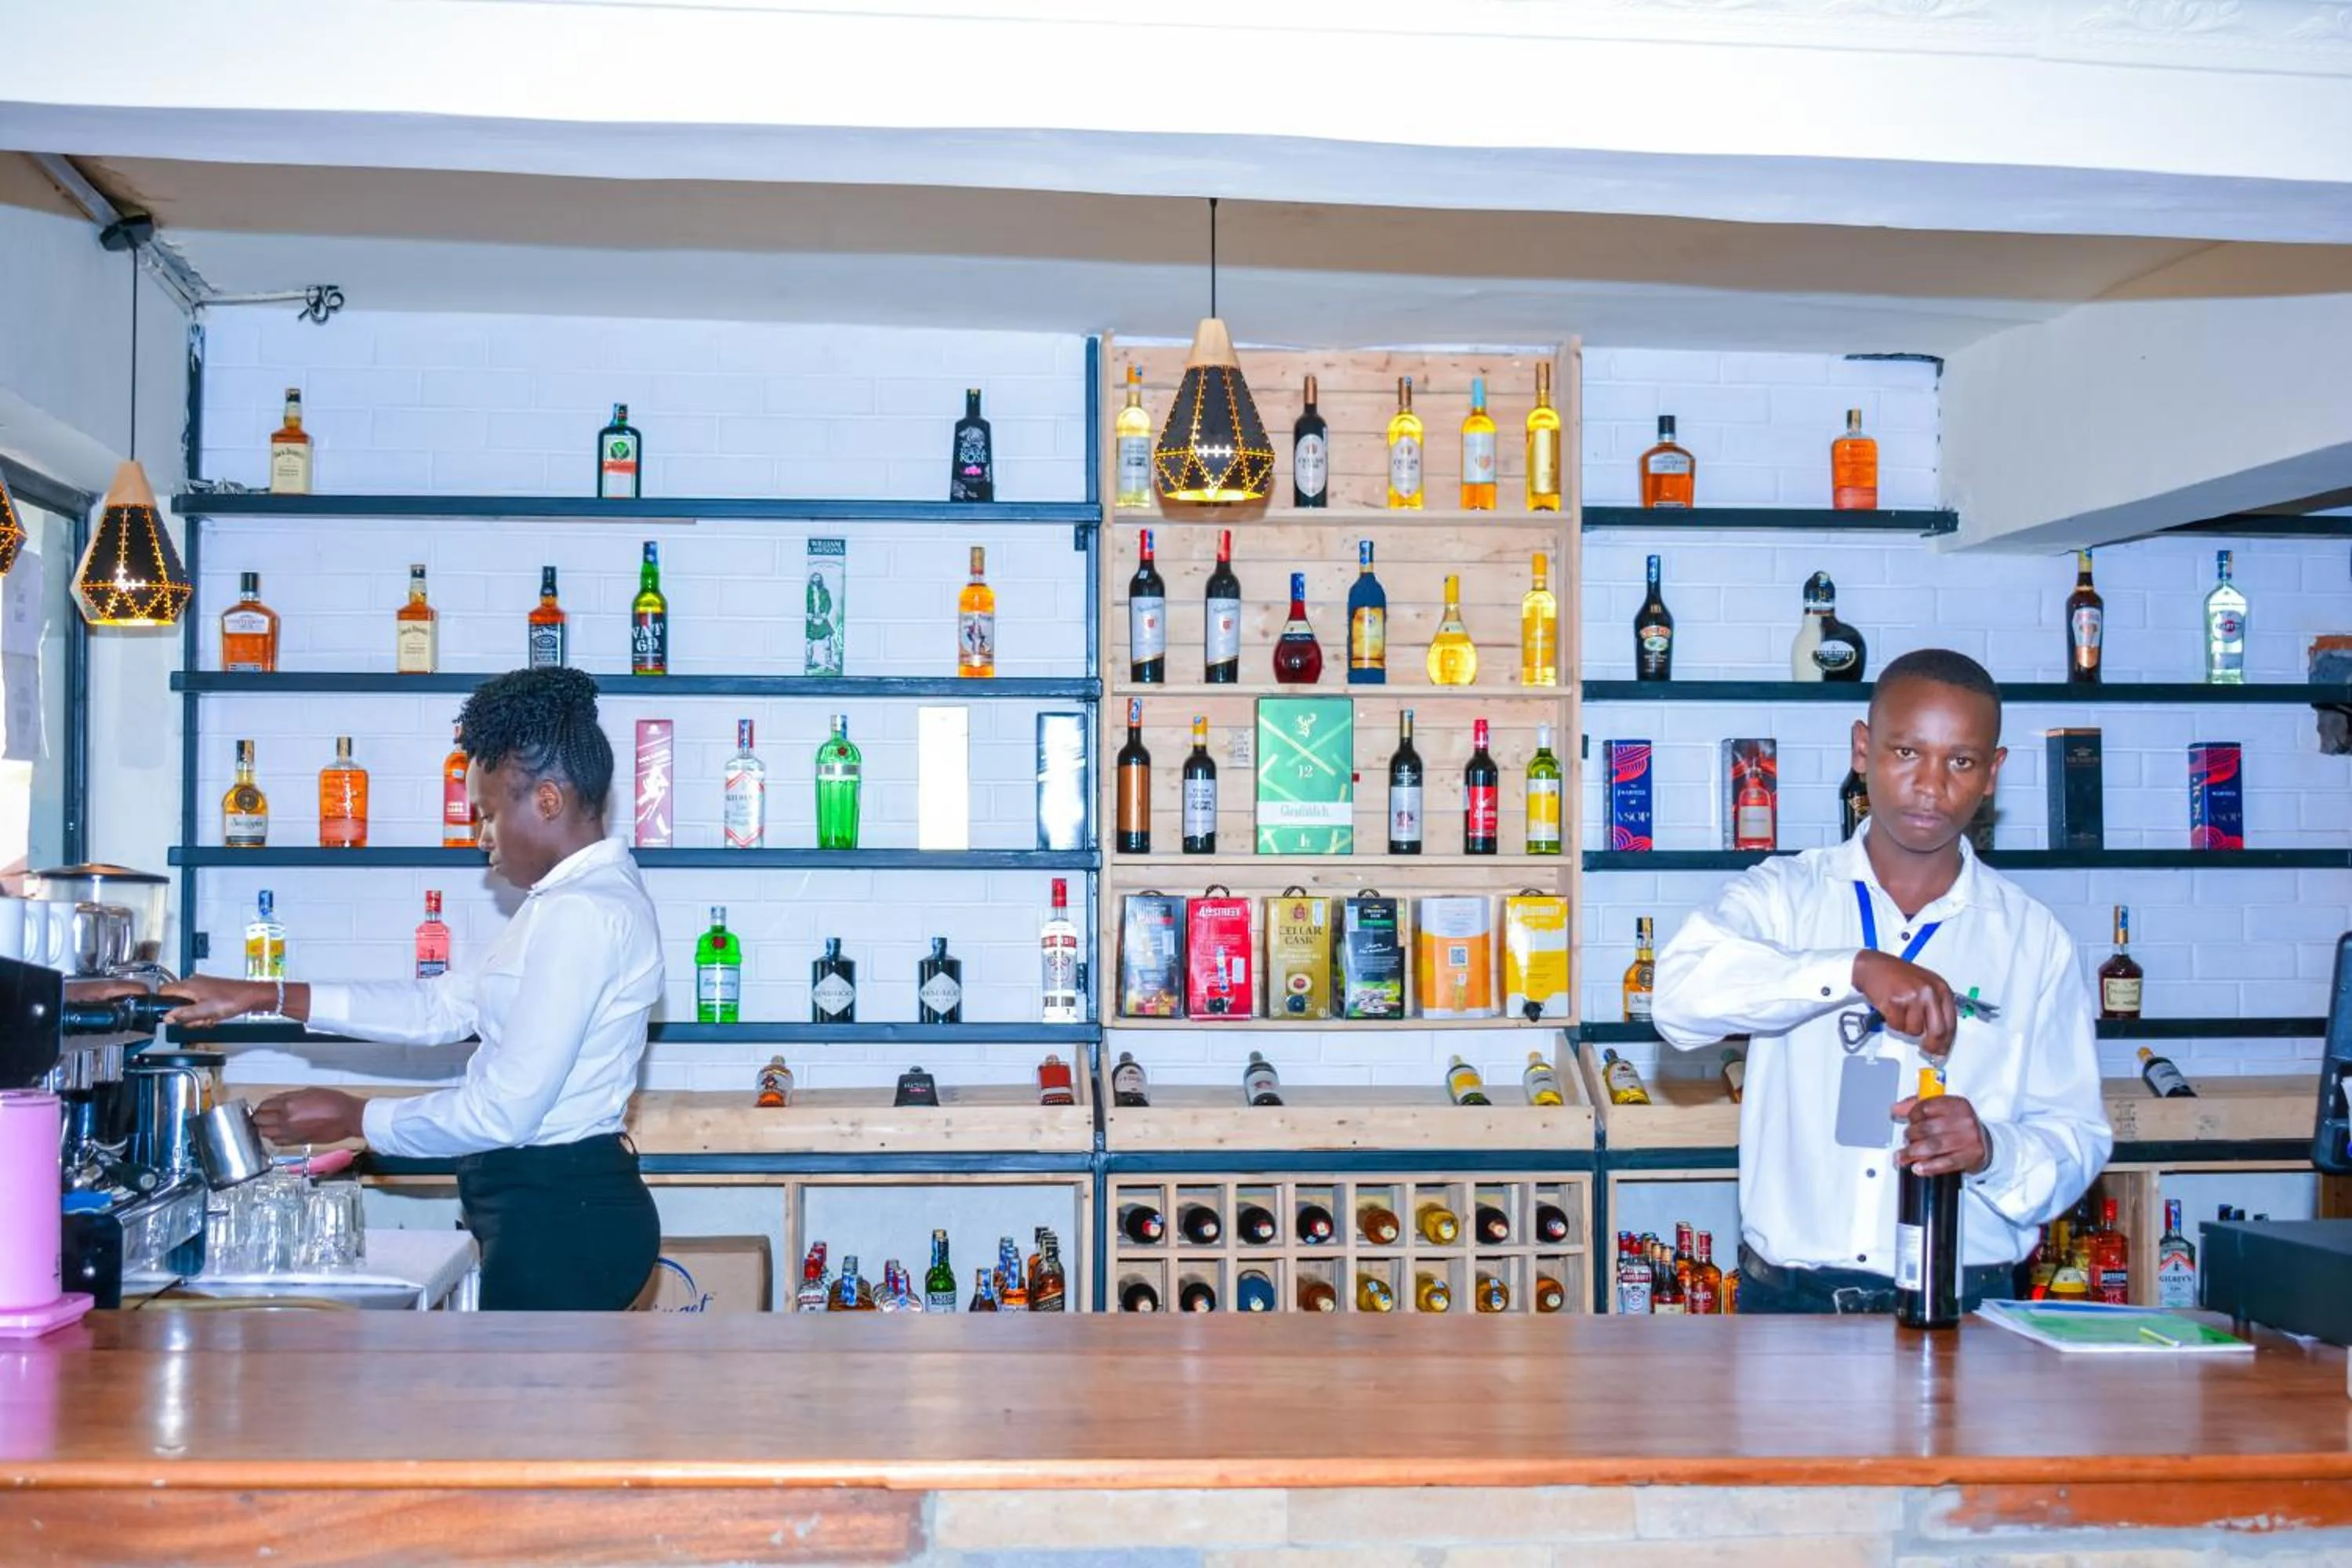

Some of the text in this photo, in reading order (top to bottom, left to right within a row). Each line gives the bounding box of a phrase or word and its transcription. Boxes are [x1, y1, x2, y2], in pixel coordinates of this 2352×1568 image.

[632, 622, 665, 639] VAT
[636, 637, 659, 652] 69
[1298, 764, 1313, 779] 12
[1279, 925, 1322, 935] CELLAR
[1285, 935, 1314, 946] CASK
